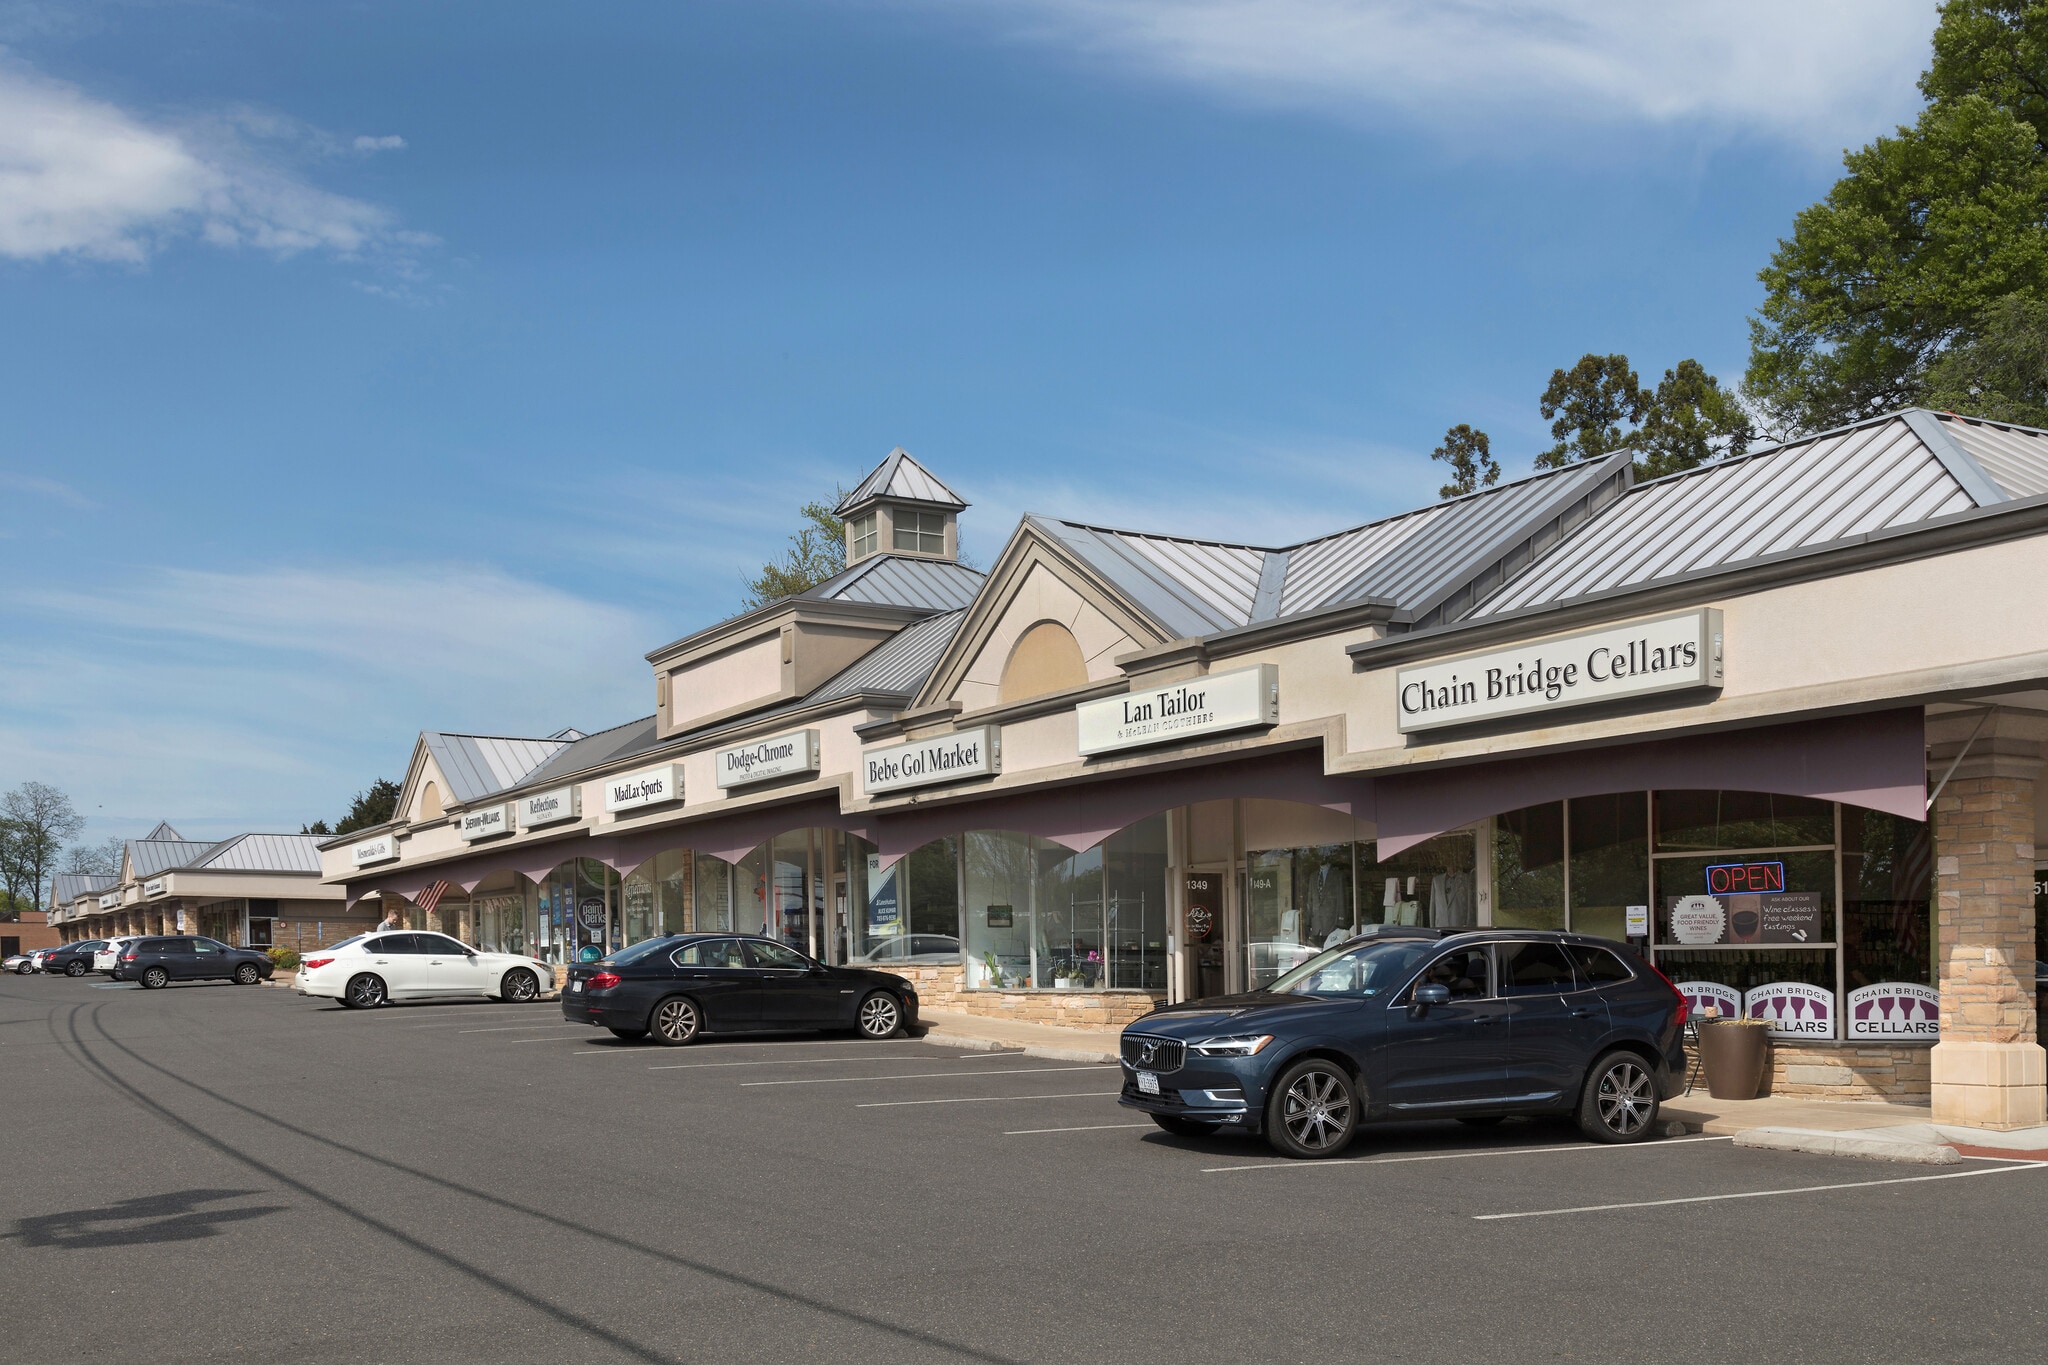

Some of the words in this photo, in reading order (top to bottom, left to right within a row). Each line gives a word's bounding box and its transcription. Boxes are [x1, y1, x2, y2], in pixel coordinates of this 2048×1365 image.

[1401, 674, 1478, 714] Chain
[1485, 657, 1578, 701] Bridge
[1587, 638, 1698, 683] Cellars
[1123, 701, 1153, 725] Lan
[1156, 687, 1206, 718] Tailor
[1162, 712, 1214, 731] CLOTHIERS
[726, 743, 794, 773] Dodge-Chrome
[869, 757, 899, 783] Bebe
[901, 749, 926, 777] Gol
[928, 741, 979, 773] Market
[614, 783, 640, 803] MadLax
[640, 779, 663, 801] Sports
[529, 796, 559, 815] Reflections
[1186, 880, 1208, 890] 1349
[1711, 865, 1782, 892] OPEN
[582, 904, 602, 917] paint
[1780, 914, 1814, 922] weekend
[585, 913, 607, 924] perks
[1764, 923, 1796, 932] tastings
[1697, 986, 1735, 1001] BRIDGE
[1751, 987, 1783, 1001] CHAIN
[1787, 987, 1828, 1002] BRIDGE
[1854, 988, 1890, 1002] CHAIN
[1895, 988, 1939, 1003] BRIDGE
[1767, 1021, 1828, 1033] LLARS
[1855, 1022, 1939, 1034] CELLARS
